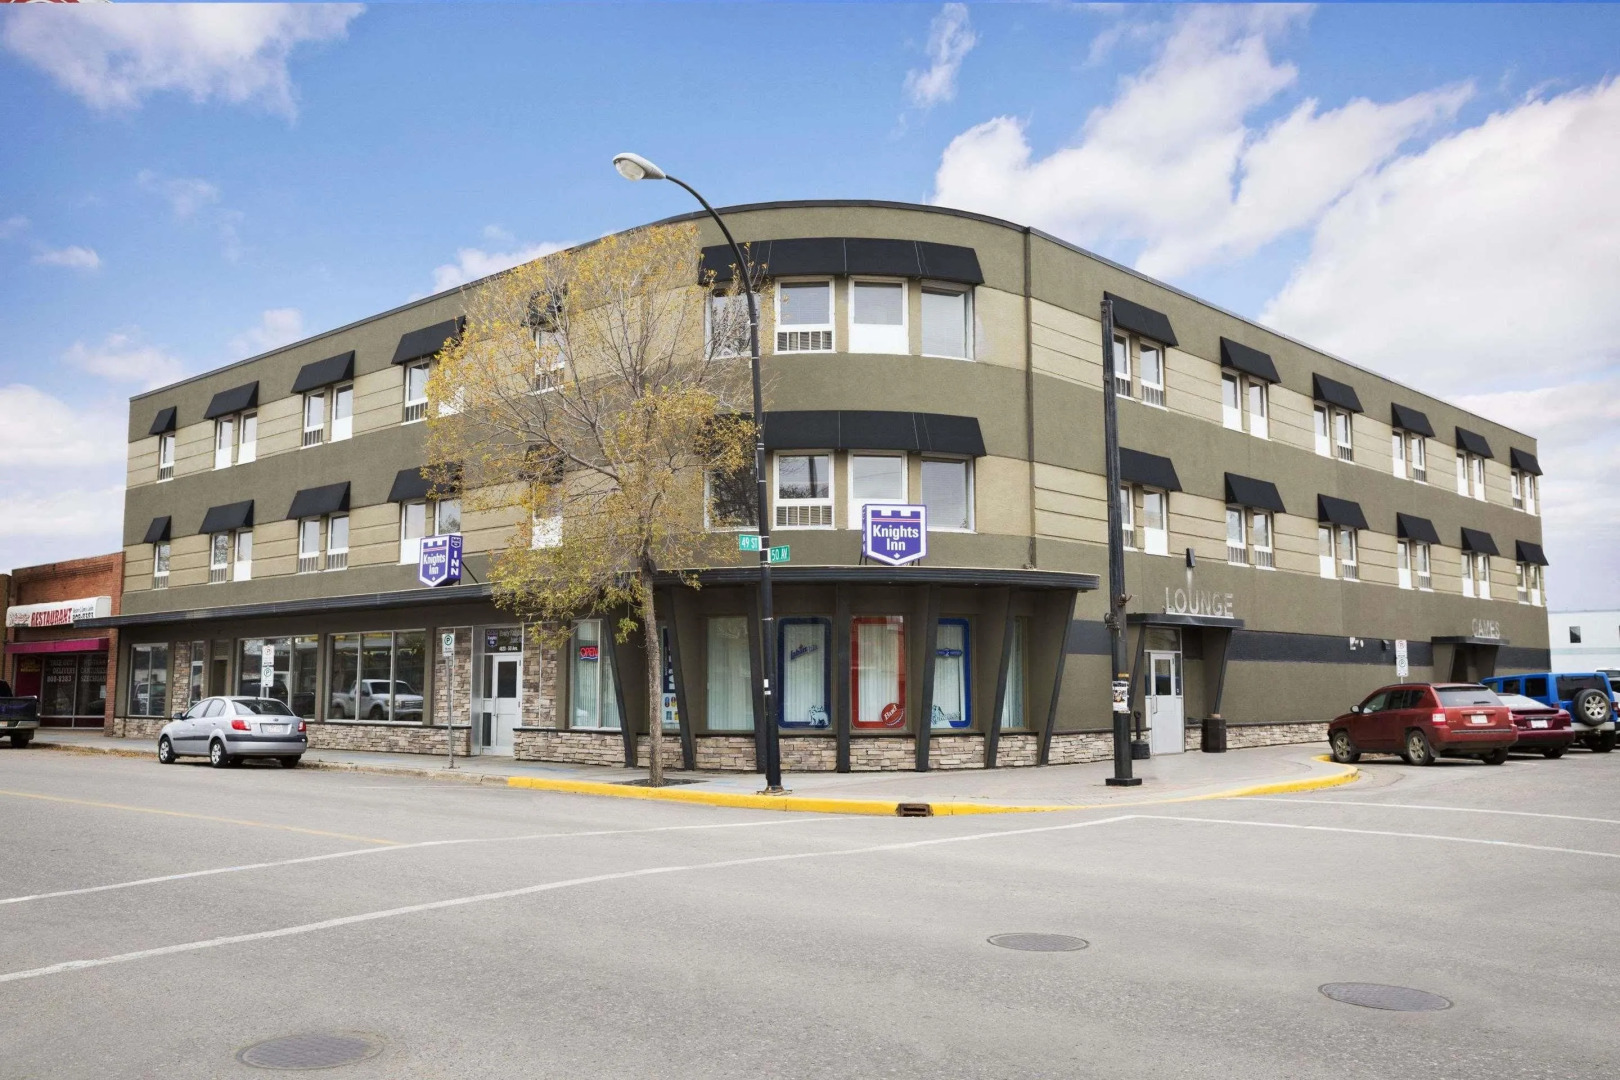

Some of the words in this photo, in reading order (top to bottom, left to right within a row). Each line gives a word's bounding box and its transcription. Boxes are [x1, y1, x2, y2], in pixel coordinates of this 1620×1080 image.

[873, 524, 919, 541] Knights
[741, 537, 750, 548] 49
[751, 537, 758, 549] ST
[886, 538, 906, 551] Inn
[423, 553, 446, 566] Knights
[771, 549, 780, 561] 50
[780, 547, 788, 560] AV
[428, 564, 439, 575] Inn
[450, 550, 460, 576] INN
[1165, 586, 1234, 618] LOUNGE
[31, 607, 73, 627] RESTAURANT
[1471, 618, 1500, 639] GAMES
[580, 647, 599, 657] OPEN
